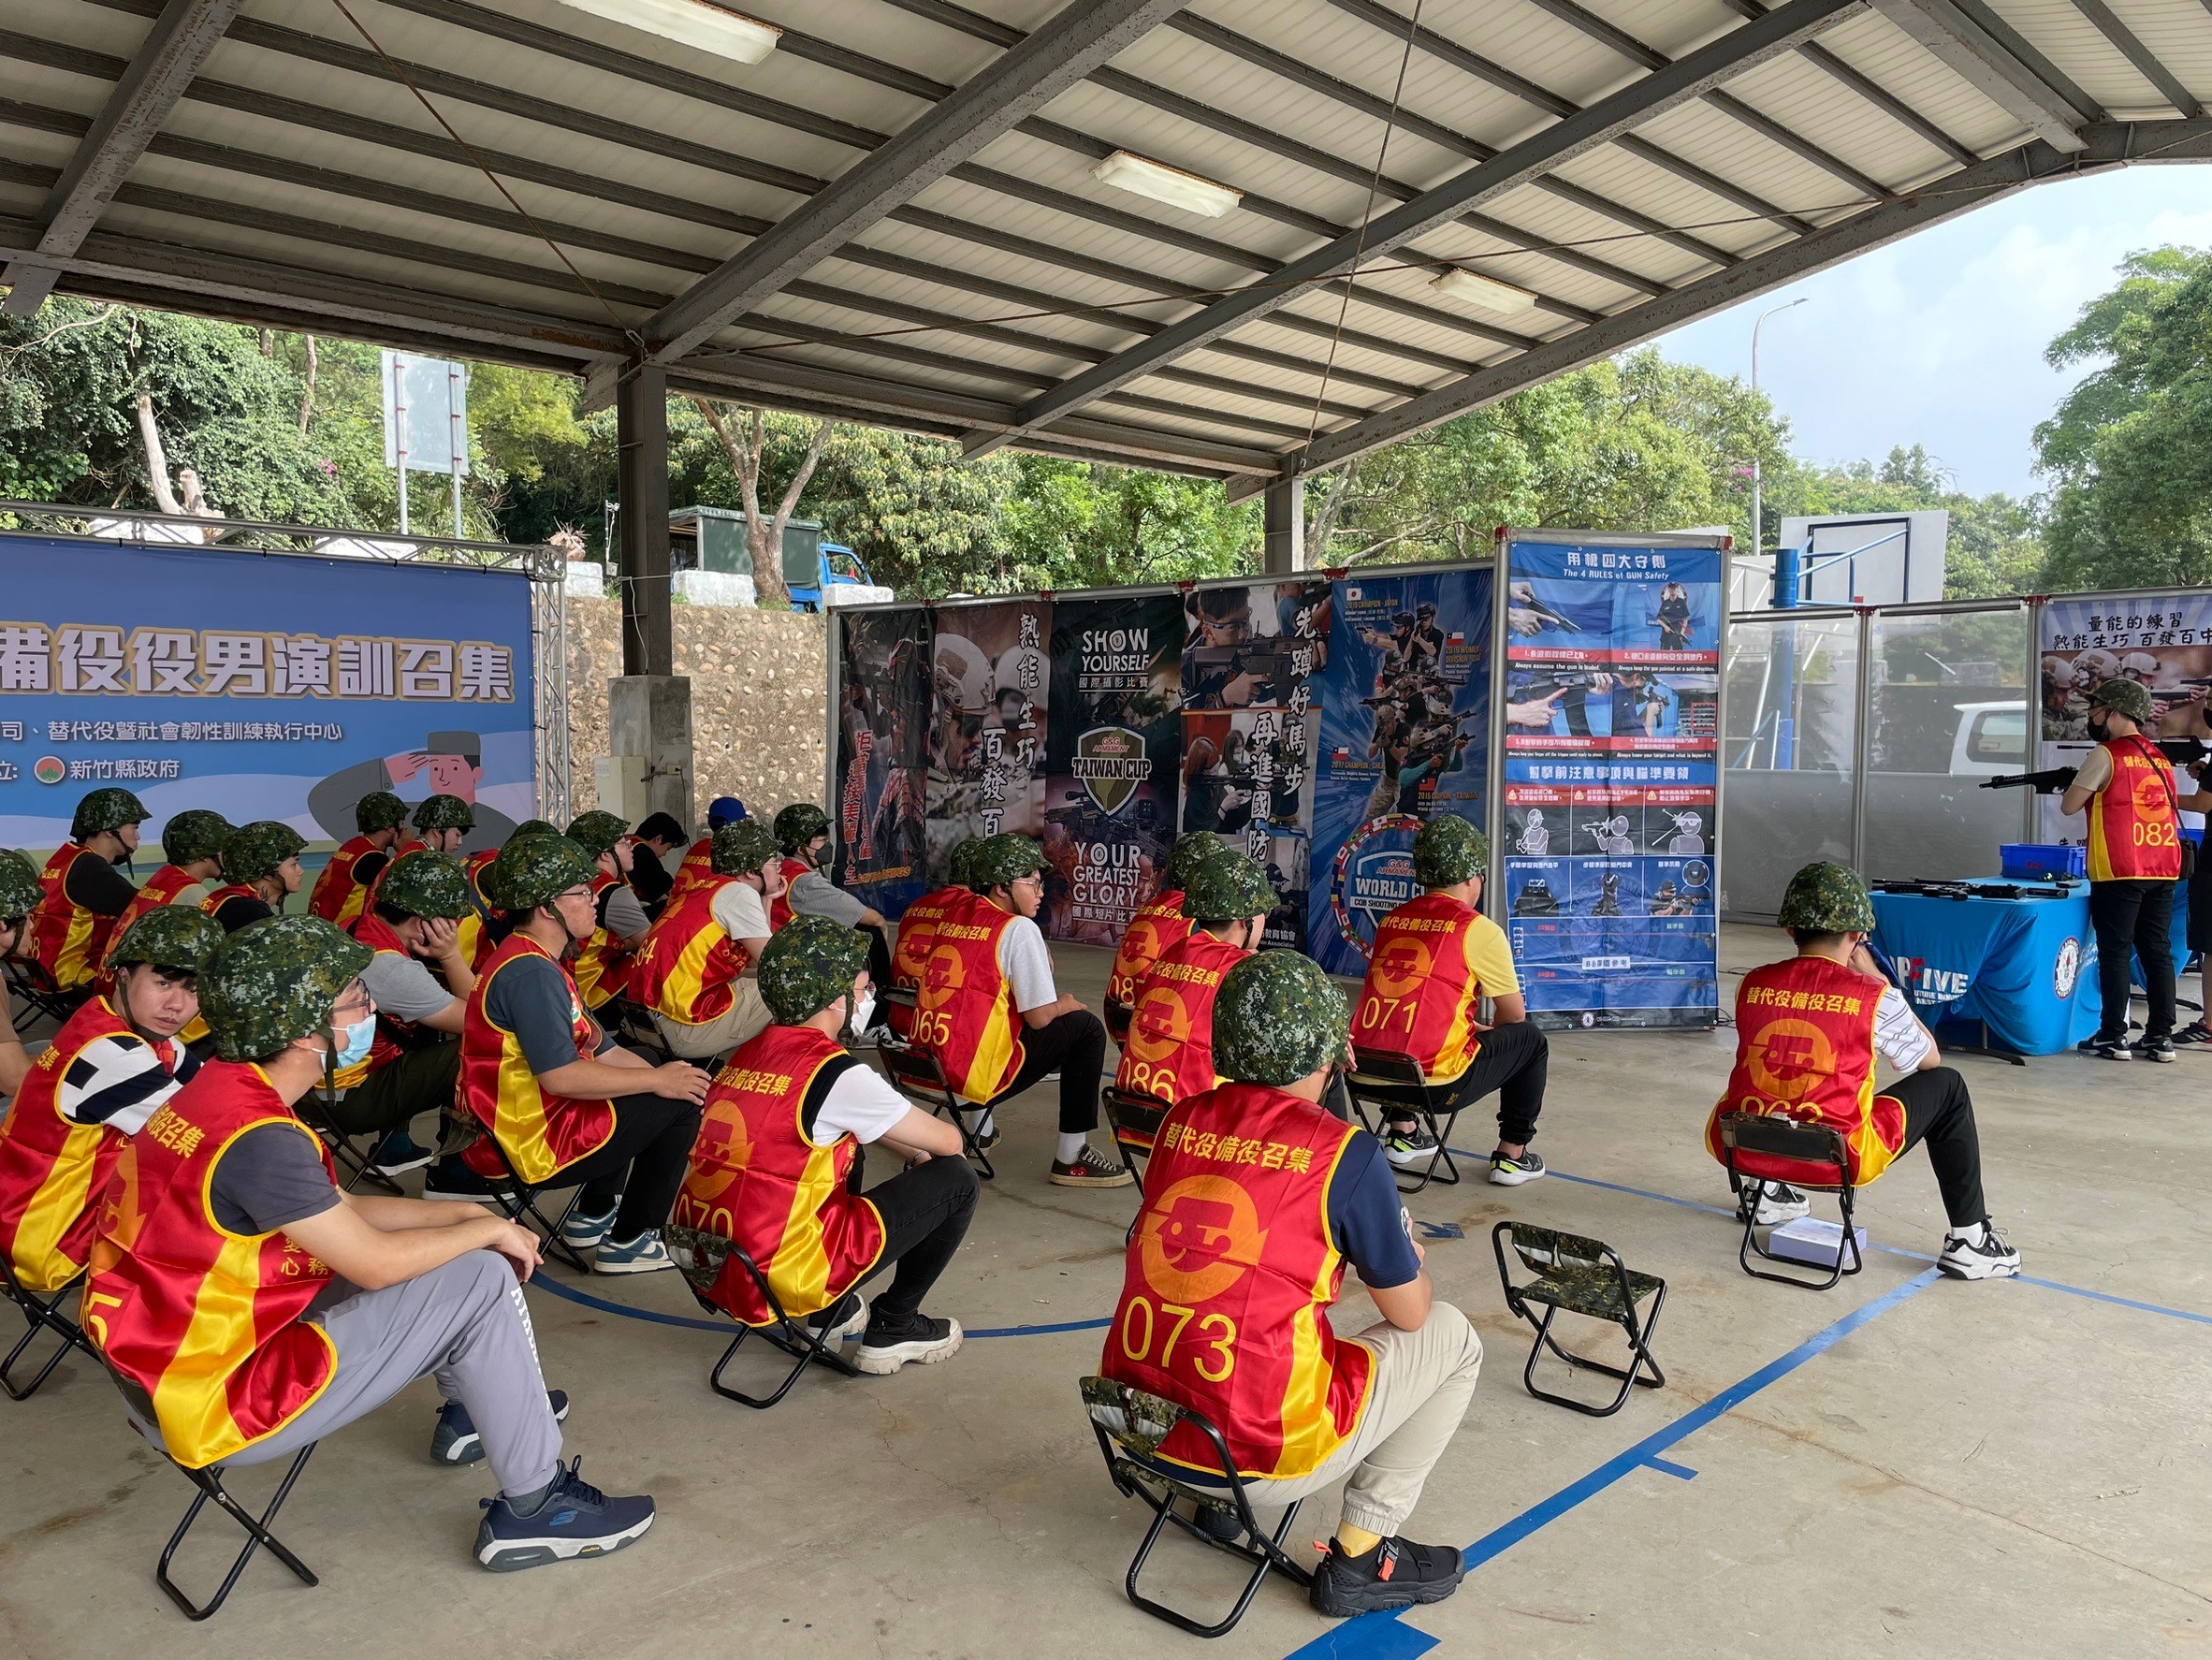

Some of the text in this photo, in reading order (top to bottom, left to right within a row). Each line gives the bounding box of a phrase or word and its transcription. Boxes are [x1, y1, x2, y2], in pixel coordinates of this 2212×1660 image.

[1567, 552, 1666, 569] 用槍四大守則
[1564, 568, 1578, 577] The
[1580, 569, 1586, 577] 4
[1589, 570, 1613, 579] RULES
[1626, 572, 1642, 580] GUN
[1645, 572, 1669, 581] Safety
[2088, 611, 2183, 633] 量能的練習
[1082, 628, 1148, 652] SHOW
[2052, 627, 2212, 650] 熟能生巧 百發百中
[0, 626, 510, 698] 備役役男演訓召集
[1082, 654, 1149, 672] YOURSELF
[1015, 613, 1041, 769] 熟能生巧
[1284, 607, 1317, 795] 先蹲好馬步
[70, 759, 180, 779] 新竹縣政府
[1072, 758, 1151, 779] TAIWAN CUP
[2133, 823, 2176, 847] 082
[1074, 842, 1141, 867] YOUR
[1389, 859, 1410, 868] G&G
[1073, 866, 1140, 886] GREATEST
[1356, 878, 1408, 898] WORLD
[1073, 883, 1138, 907] GLORY
[1746, 986, 1862, 1016] 替代役備役召集
[910, 1008, 953, 1046] 065
[1362, 997, 1419, 1034] 071
[1118, 1057, 1176, 1103] 086
[1163, 1122, 1314, 1175] 替代役備役召集
[677, 1193, 733, 1240] 070
[1123, 1296, 1238, 1383] 073
